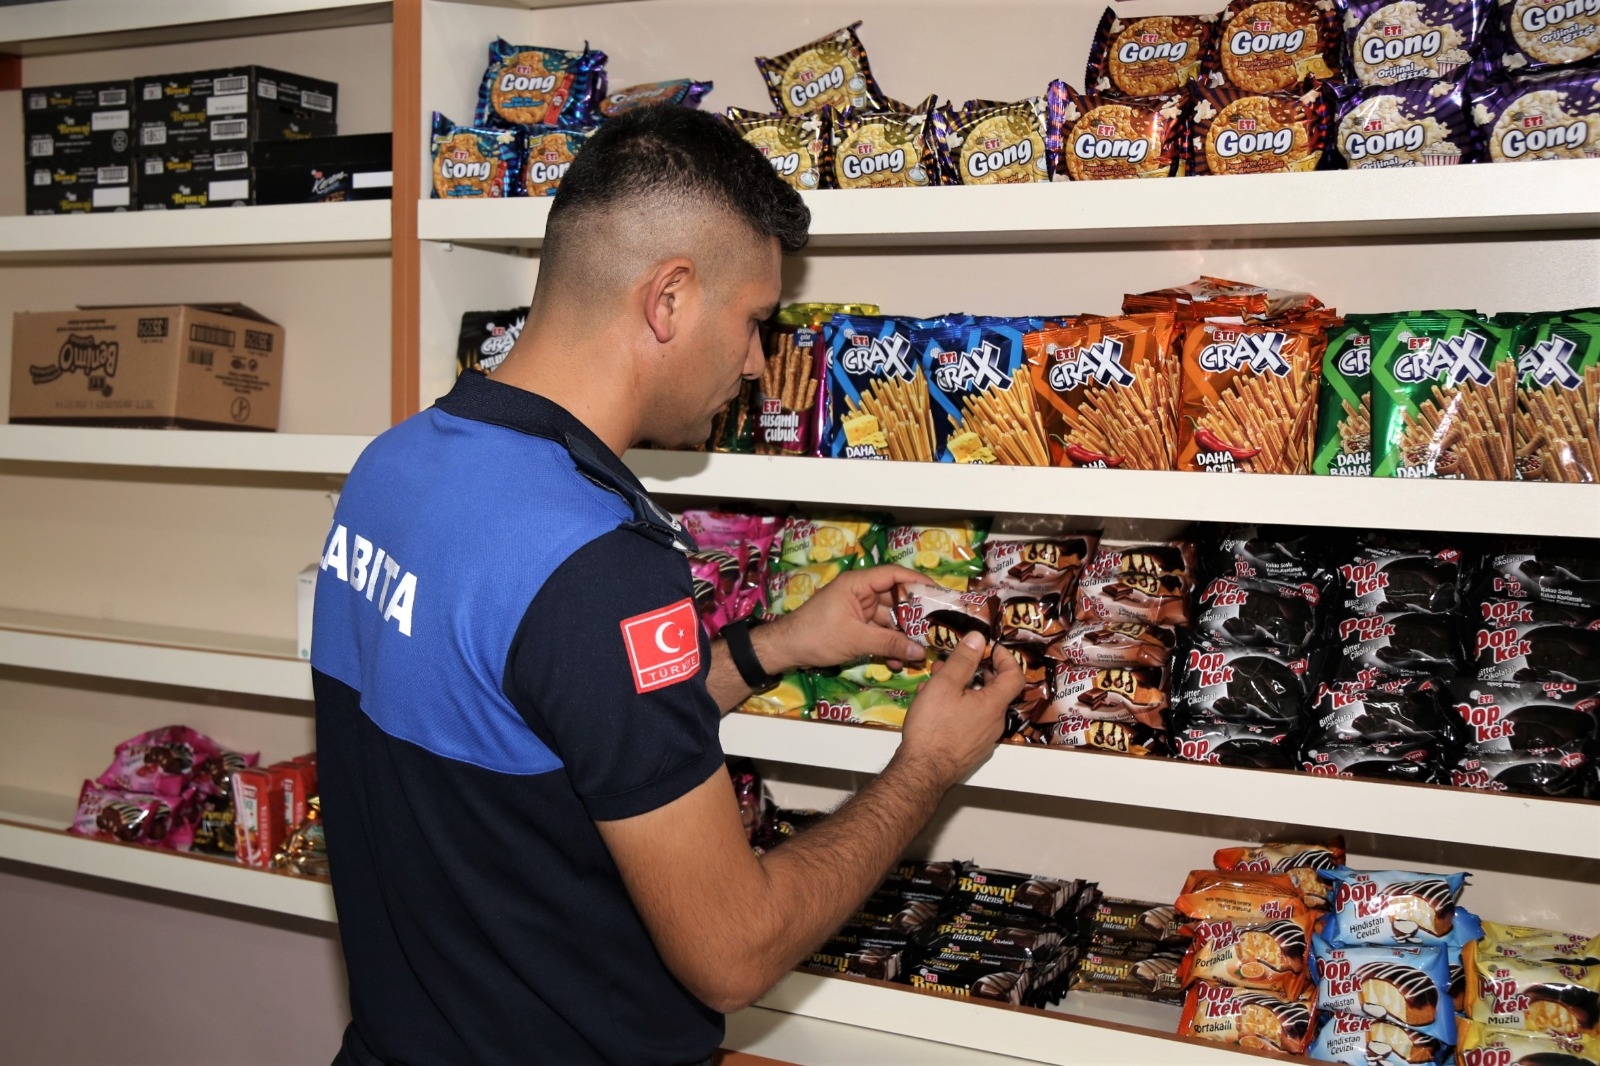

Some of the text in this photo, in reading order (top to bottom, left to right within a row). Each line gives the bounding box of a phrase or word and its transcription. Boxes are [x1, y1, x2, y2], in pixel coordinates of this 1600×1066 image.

[1521, 0, 1600, 33] Gong
[1253, 21, 1272, 32] ETi
[1384, 25, 1402, 37] ETi
[1541, 24, 1580, 44] Orijinal
[1141, 33, 1158, 43] ETi
[1230, 29, 1305, 56] Gong
[1118, 41, 1188, 64] Gong
[1362, 31, 1442, 65] Gong
[1377, 62, 1415, 79] Orijinal
[500, 73, 556, 93] Gong
[789, 65, 845, 107] Gong
[1096, 125, 1115, 136] ETi
[1237, 119, 1256, 130] ETi
[1523, 115, 1544, 128] ETi
[857, 143, 873, 154] ETi
[984, 139, 1001, 150] ETi
[1074, 133, 1148, 163] Gong
[1215, 128, 1292, 157] Gong
[1345, 124, 1425, 160] Gong
[1502, 121, 1588, 158] Gong
[770, 152, 800, 176] ng
[842, 148, 905, 180] Gong
[967, 138, 1033, 178] Gong
[441, 158, 491, 181] Gong
[530, 161, 571, 184] Gon
[852, 335, 869, 347] ETi
[1213, 331, 1234, 341] ETi
[1353, 335, 1370, 346] ET
[842, 332, 916, 384] CRAX
[938, 352, 957, 365] ETi
[1055, 348, 1075, 361] ETi
[1199, 331, 1292, 377] CRAX
[1393, 329, 1496, 387] CRAX
[1517, 333, 1583, 391] AX
[935, 339, 1014, 393] CRAX
[1049, 335, 1136, 392] CRAX
[763, 400, 781, 414] ETi
[759, 411, 799, 428] susamlı
[765, 427, 800, 443] çubuk
[846, 444, 876, 458] DAHA
[1196, 451, 1234, 466] DAHA
[1396, 466, 1437, 478] DAHA
[792, 525, 818, 542] kek
[893, 531, 920, 551] kek
[321, 522, 418, 637] ABITA
[1340, 561, 1377, 586] Pop
[1355, 572, 1389, 598] kek
[1212, 590, 1248, 607] kek
[898, 602, 924, 624] Pop
[1480, 601, 1519, 622] Pop
[904, 619, 930, 637] kek
[1339, 615, 1384, 641] Pop
[1359, 624, 1395, 642] kek
[1474, 628, 1518, 661] Pop
[1494, 640, 1532, 664] kek
[1188, 649, 1225, 671] Pop
[1067, 668, 1098, 685] kek
[1199, 666, 1234, 688] kek
[1478, 665, 1496, 677] itter
[1332, 693, 1368, 710] kek
[1478, 695, 1494, 704] ETi
[815, 699, 852, 721] Pop
[1453, 704, 1500, 726] Pop
[1059, 719, 1092, 736] kek
[1319, 711, 1336, 728] Bitter
[1475, 719, 1515, 743] kek
[1315, 753, 1328, 763] ETi
[1405, 751, 1424, 763] Yeni
[959, 877, 1016, 903] Browni
[975, 892, 1005, 905] intense
[1335, 882, 1377, 913] Pop
[1356, 895, 1395, 918] kek
[1095, 911, 1137, 929] Browni
[1102, 922, 1127, 931] intense
[1350, 918, 1384, 933] Hindistan
[937, 924, 998, 941] Browni
[952, 933, 984, 942] intense
[1195, 921, 1233, 949] Pop
[1212, 930, 1240, 952] kek
[1356, 927, 1380, 939] Cevizli
[809, 953, 849, 972] rowni
[1195, 950, 1233, 968] Portakallı
[1332, 951, 1344, 959] ETi
[1079, 959, 1129, 980] Browni
[1093, 972, 1119, 981] intense
[1317, 958, 1350, 981] Pop
[1497, 969, 1510, 977] ETi
[910, 974, 970, 997] Browni
[1329, 976, 1362, 998] kek
[1207, 997, 1242, 1019] kek
[1493, 996, 1531, 1014] kek
[1194, 1021, 1232, 1034] Portakallı
[1335, 1018, 1371, 1034] kek
[1488, 1015, 1520, 1026] Muzlu
[1327, 1036, 1360, 1049] Hindistan
[1331, 1045, 1354, 1055] Cevizli
[1464, 1047, 1512, 1066] Pop
